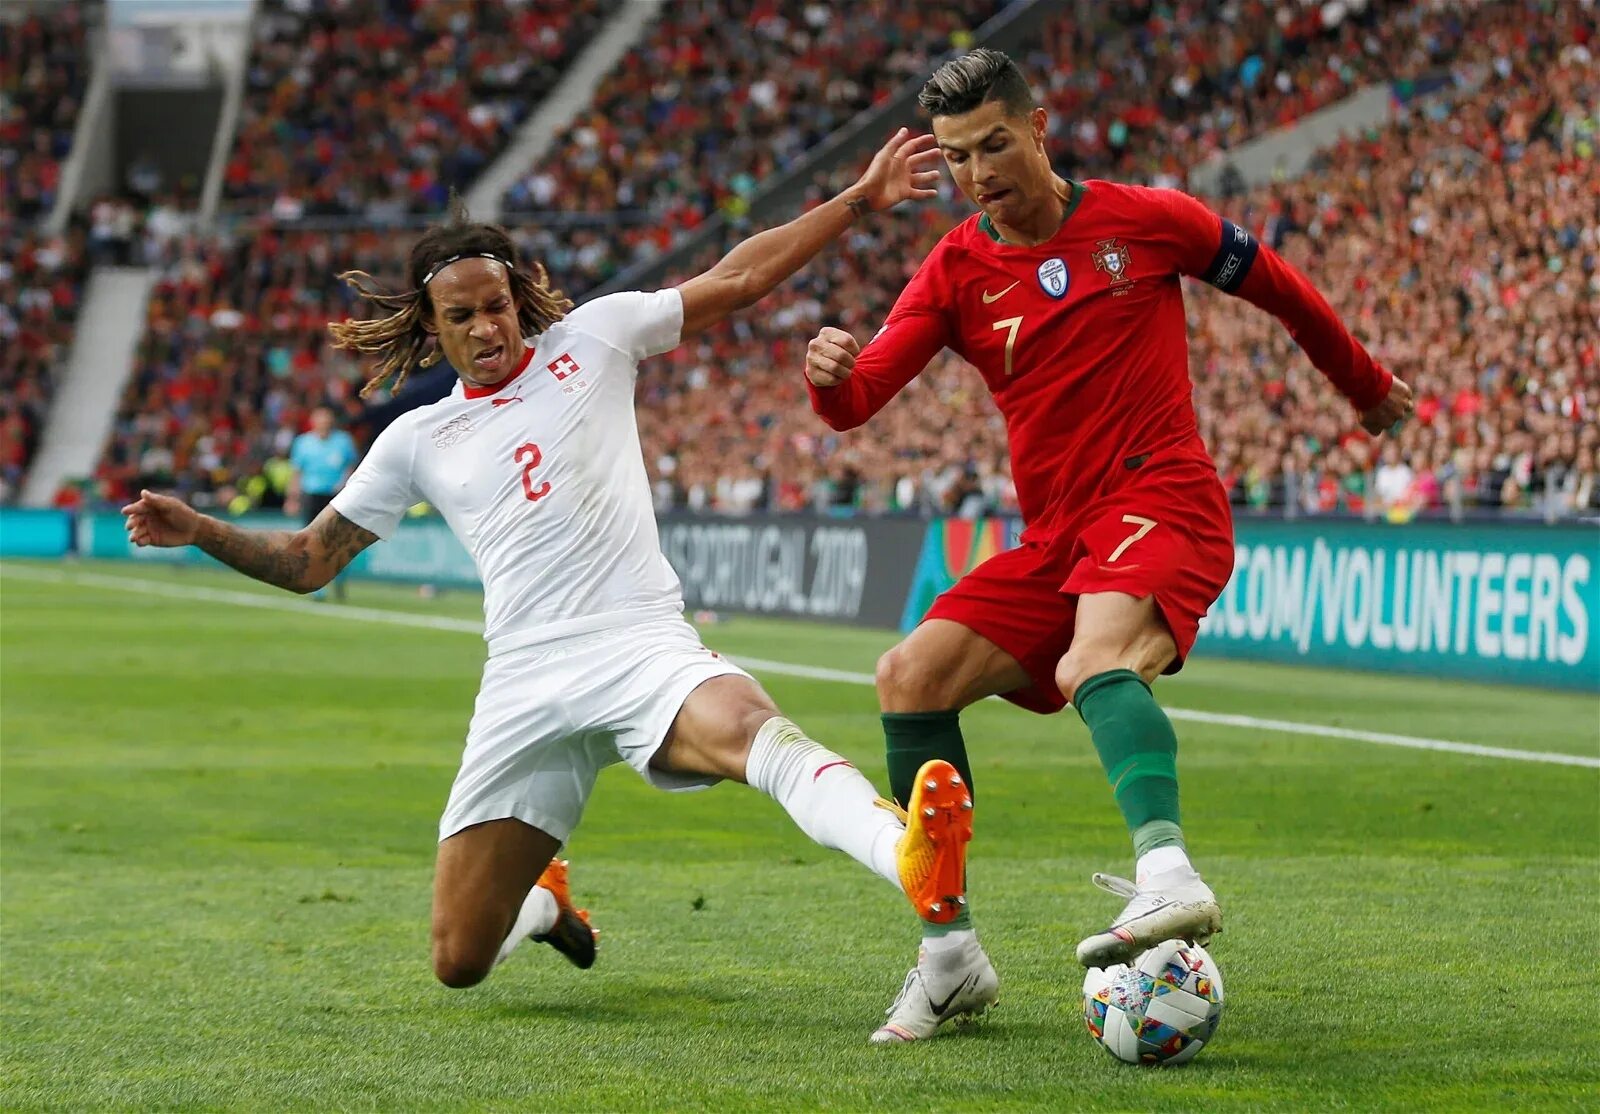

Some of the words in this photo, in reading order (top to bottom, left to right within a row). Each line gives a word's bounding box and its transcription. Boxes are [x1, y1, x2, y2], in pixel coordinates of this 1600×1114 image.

[1216, 253, 1239, 286] SPECT
[992, 315, 1024, 376] 7
[514, 443, 551, 502] 2
[1107, 514, 1158, 562] 7
